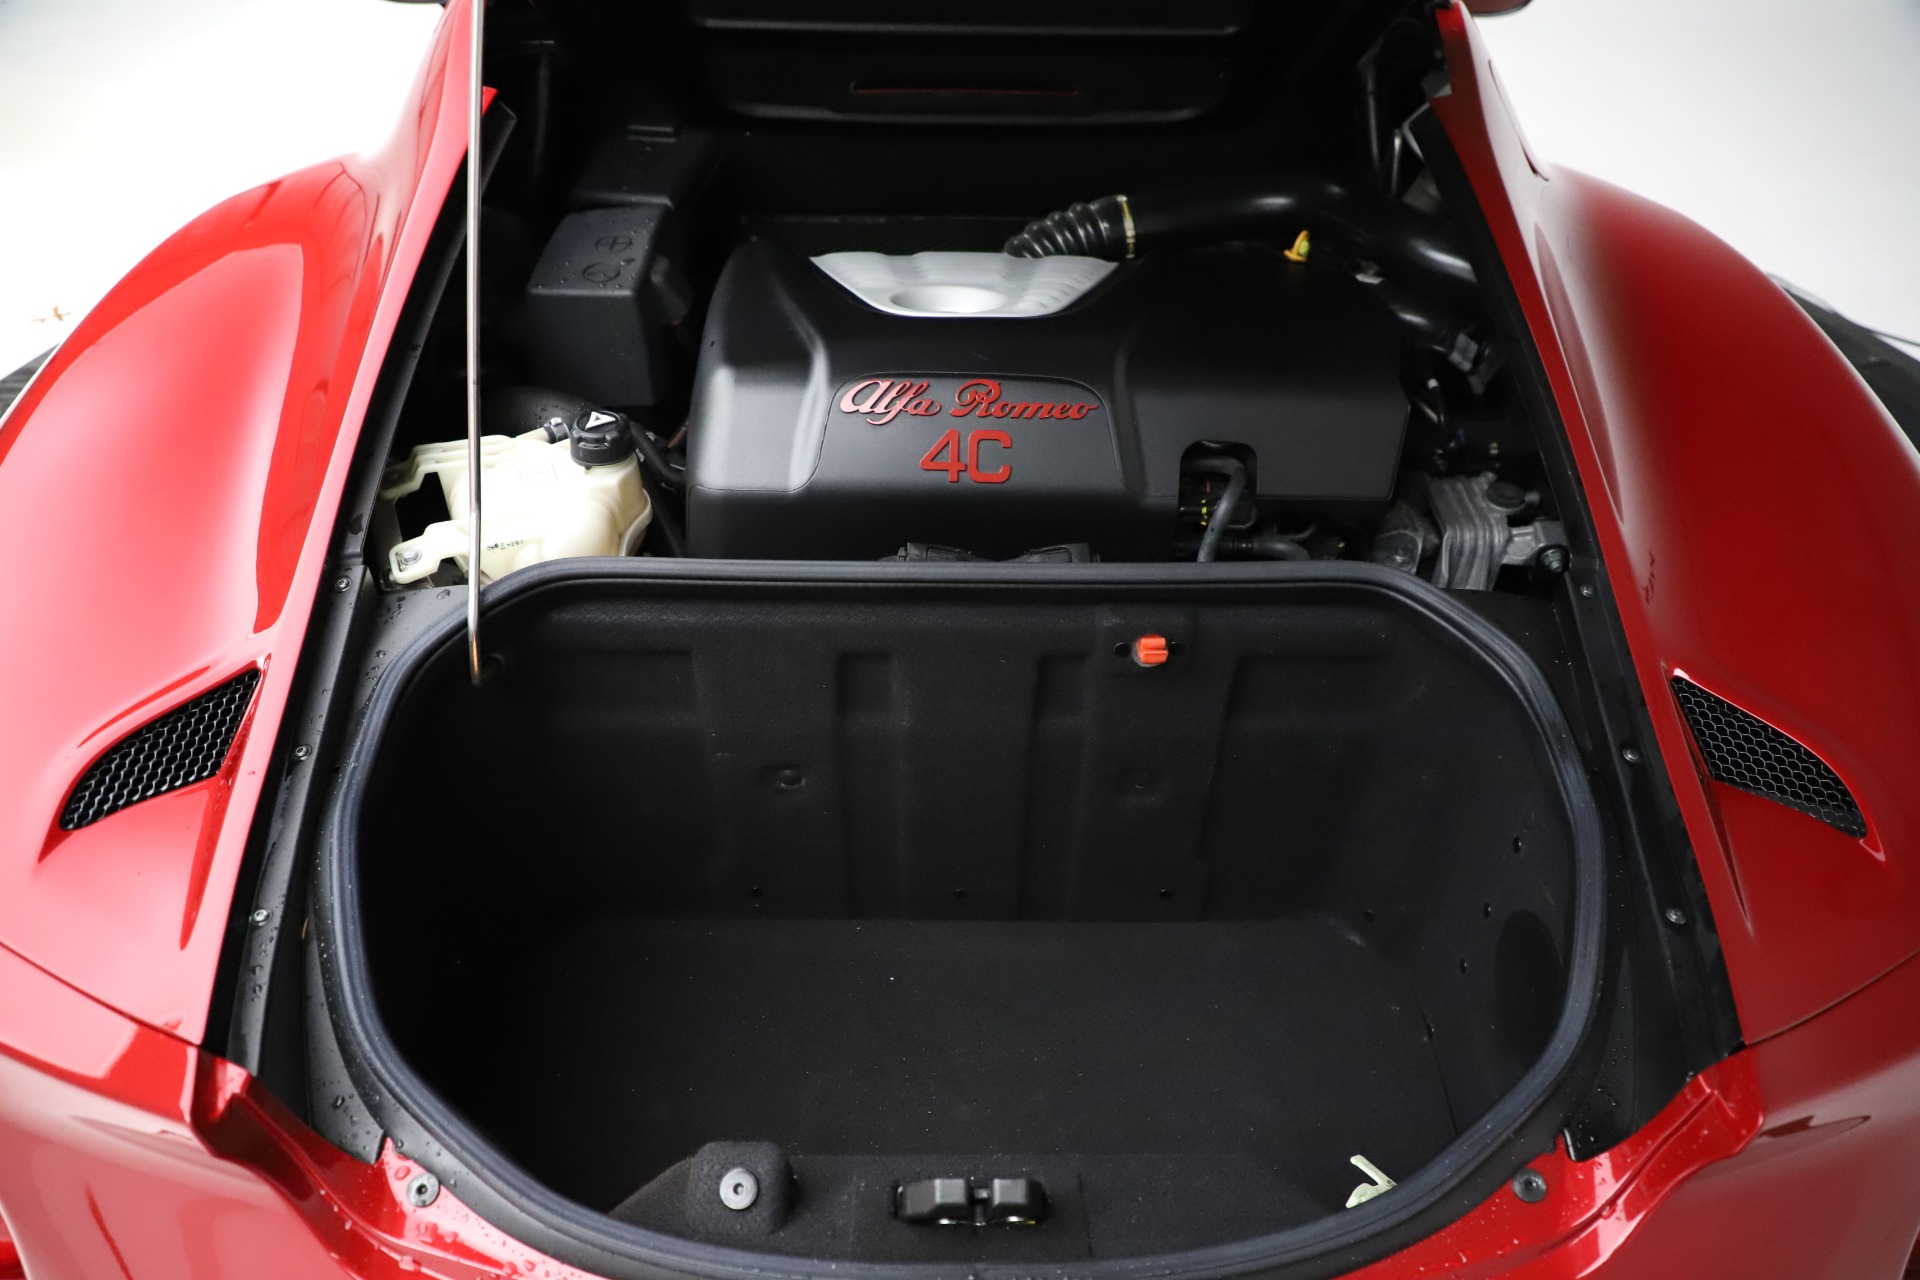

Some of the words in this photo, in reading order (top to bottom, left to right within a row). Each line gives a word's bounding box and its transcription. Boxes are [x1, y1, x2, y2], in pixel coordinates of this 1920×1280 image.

[839, 379, 942, 425] Alfa
[949, 378, 1099, 420] Romeo
[919, 428, 1012, 484] 4C
